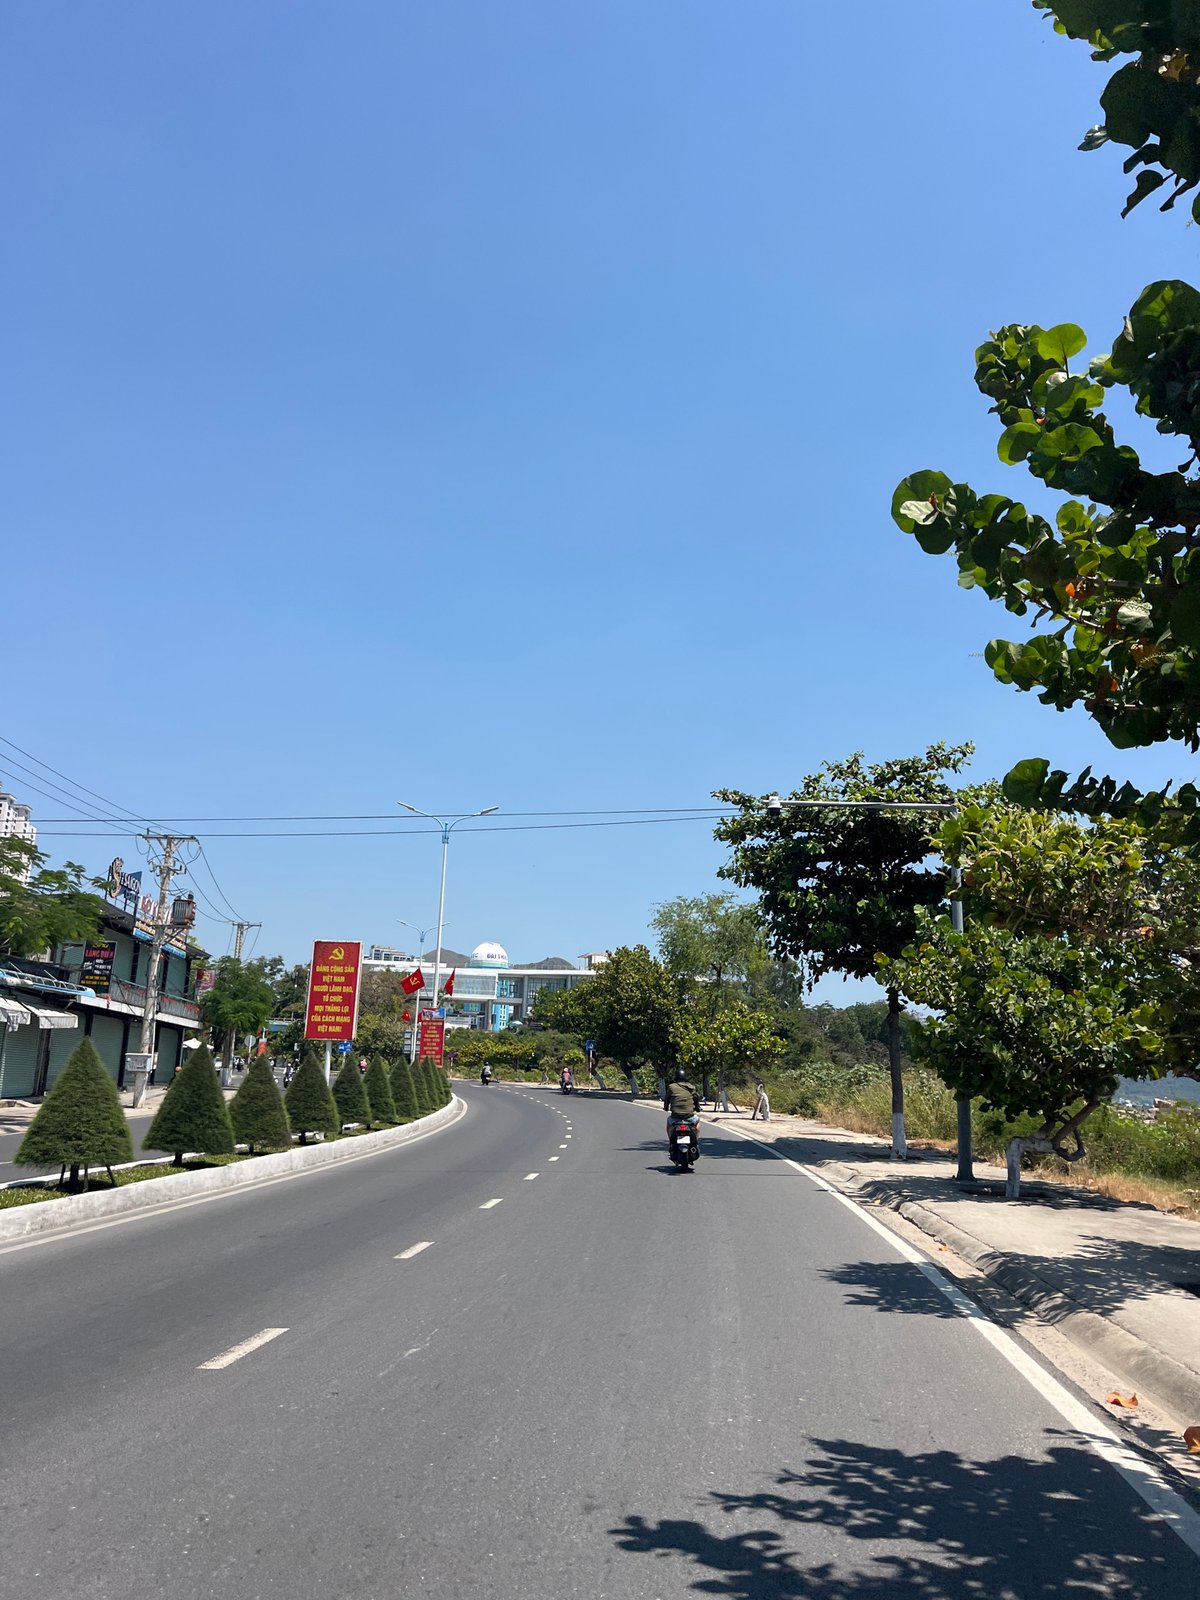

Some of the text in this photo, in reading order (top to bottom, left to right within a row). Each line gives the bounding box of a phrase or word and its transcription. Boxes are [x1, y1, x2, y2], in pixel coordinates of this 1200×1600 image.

[316, 965, 354, 974] ĐẢNG CỘNG SẢN
[322, 974, 333, 983] VIỆT
[325, 1004, 340, 1012] THẮNG
[311, 1014, 321, 1022] CỦA
